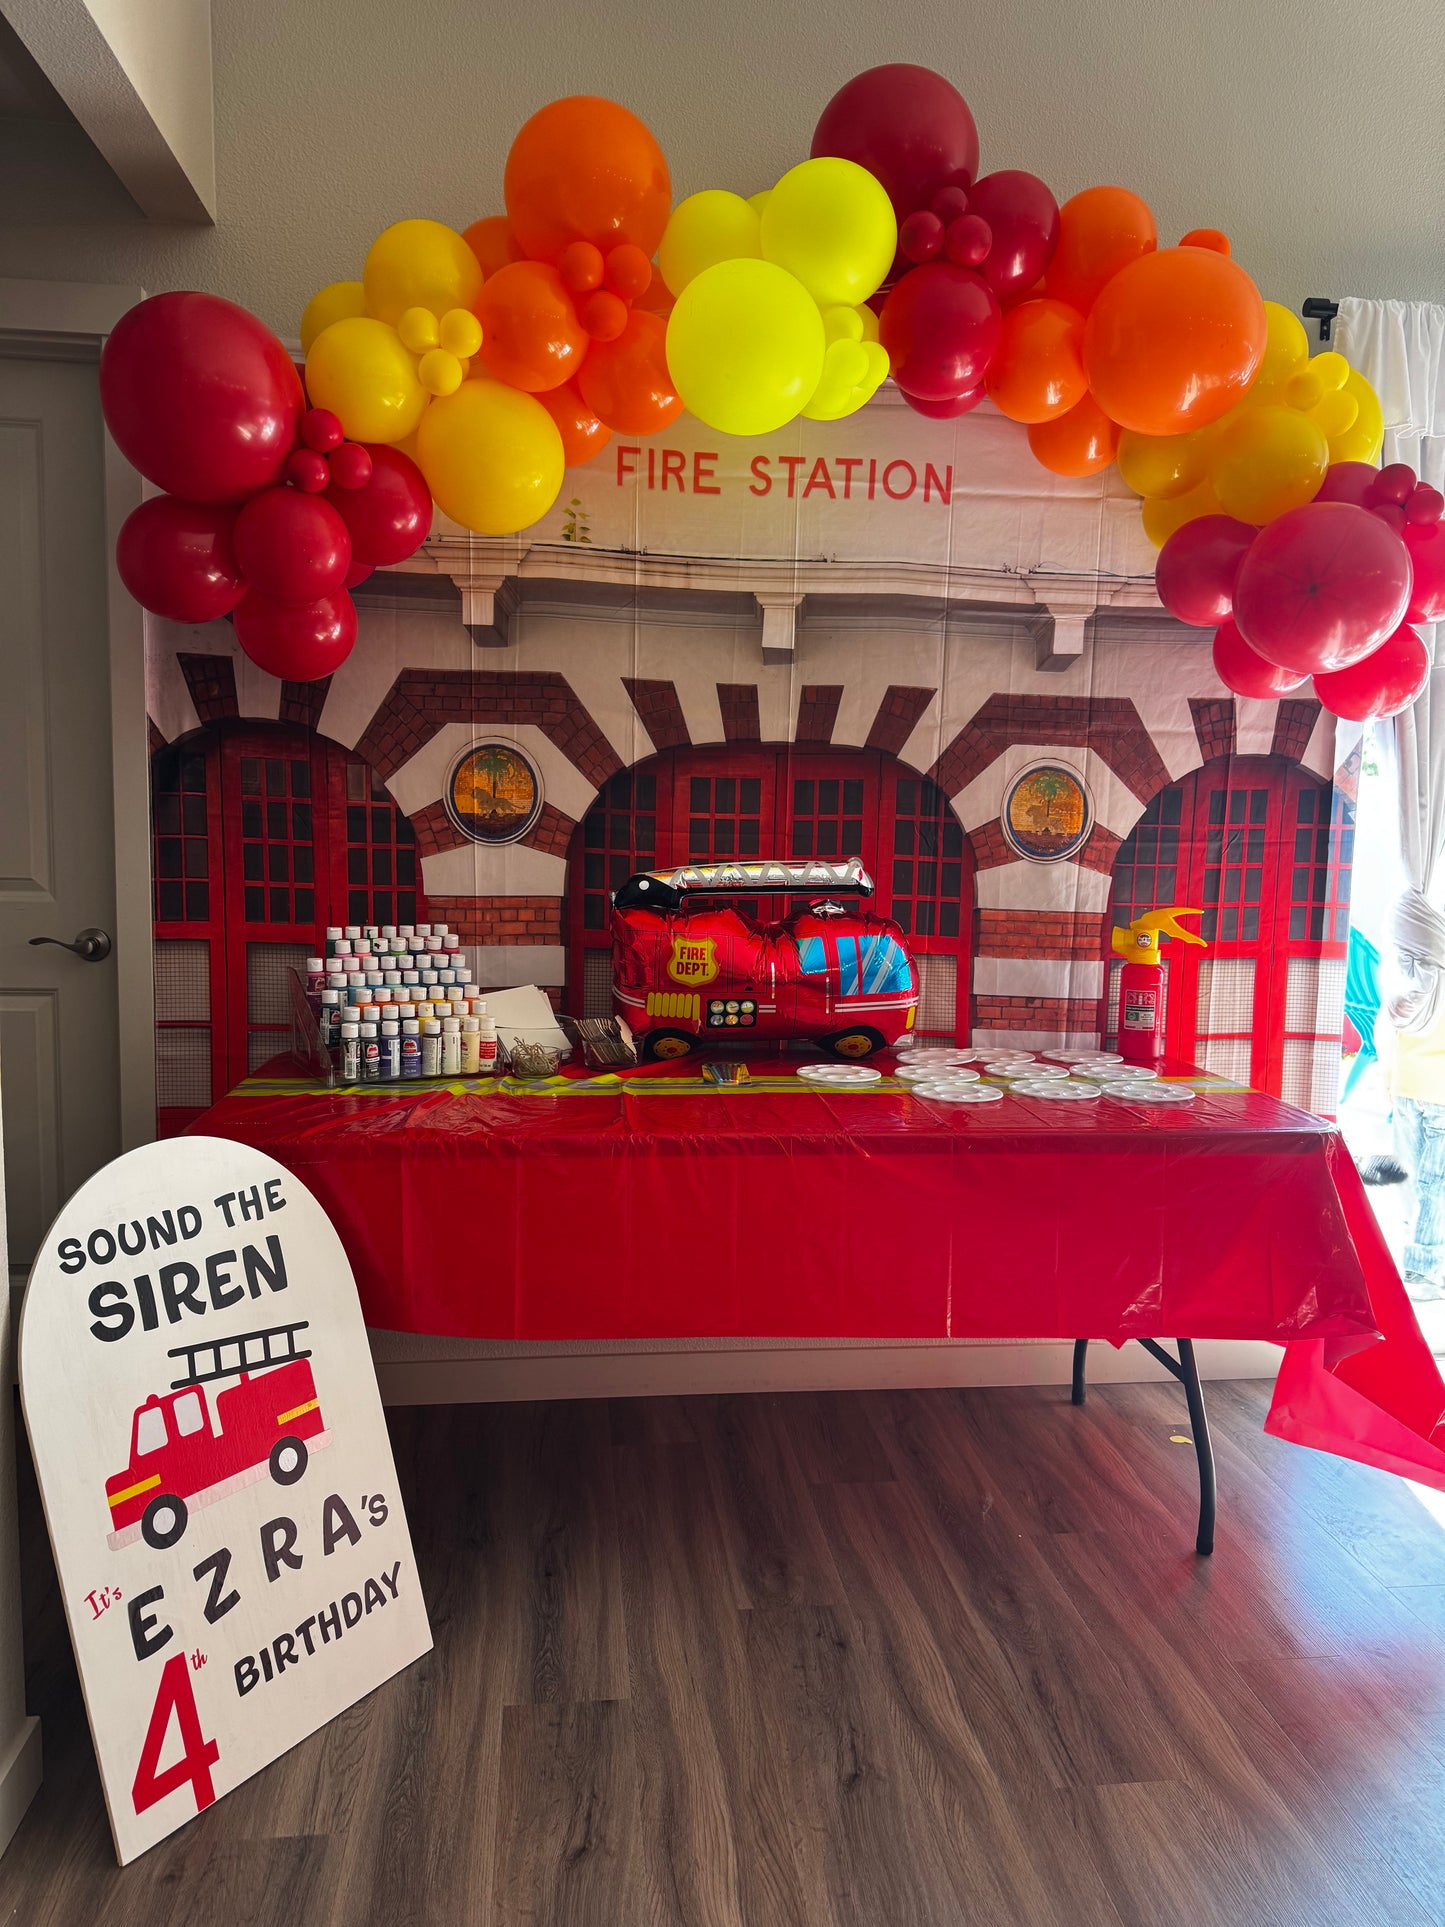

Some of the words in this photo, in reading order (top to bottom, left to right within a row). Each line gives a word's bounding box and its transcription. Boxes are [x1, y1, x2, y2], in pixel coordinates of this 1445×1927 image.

[616, 445, 721, 495] FIRE
[749, 455, 953, 506] STATION
[676, 961, 709, 976] DEPT.
[680, 946, 706, 960] FIRE
[57, 1205, 203, 1275] SOUND
[213, 1178, 287, 1228] THE
[88, 1234, 288, 1343] SIREN
[83, 1586, 123, 1620] It's
[234, 1560, 402, 1698] BIRTHDAY
